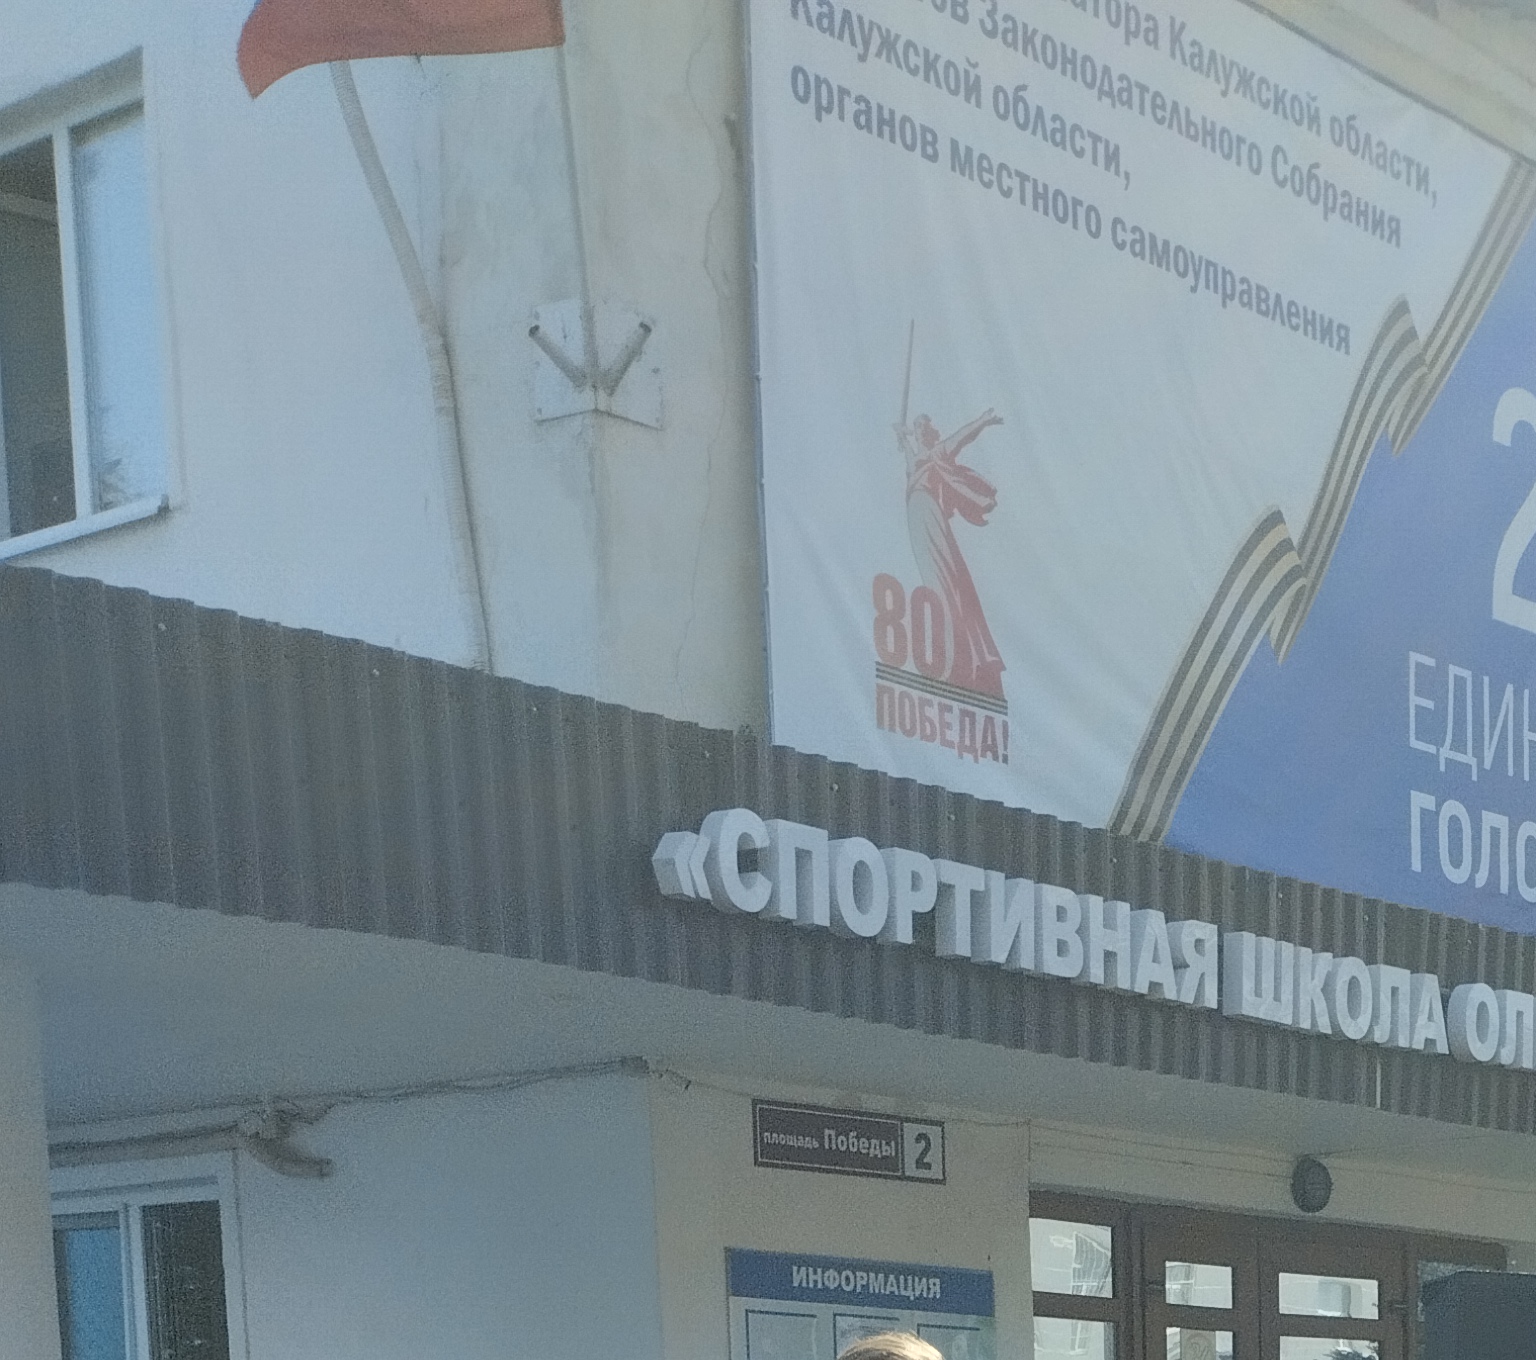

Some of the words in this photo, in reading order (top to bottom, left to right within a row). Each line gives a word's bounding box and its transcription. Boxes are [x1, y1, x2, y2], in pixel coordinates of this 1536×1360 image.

[978, 0, 1263, 176] Законодательного
[1271, 144, 1402, 249] Собрания
[992, 83, 1131, 191] области,
[1168, 15, 1322, 137] Калужской
[1329, 114, 1438, 209] области,
[790, 65, 940, 164] органов
[950, 136, 1101, 240] местного
[1110, 216, 1351, 356] самоуправления
[872, 572, 946, 681] 80
[875, 683, 1010, 765] ПОБЕДА!
[1223, 931, 1450, 1056] ШКОЛА
[763, 1131, 820, 1150] площадь
[823, 1128, 896, 1157] Победы
[914, 1131, 933, 1171] 2
[791, 1264, 942, 1300] ИНФОРМАЦИЯ
